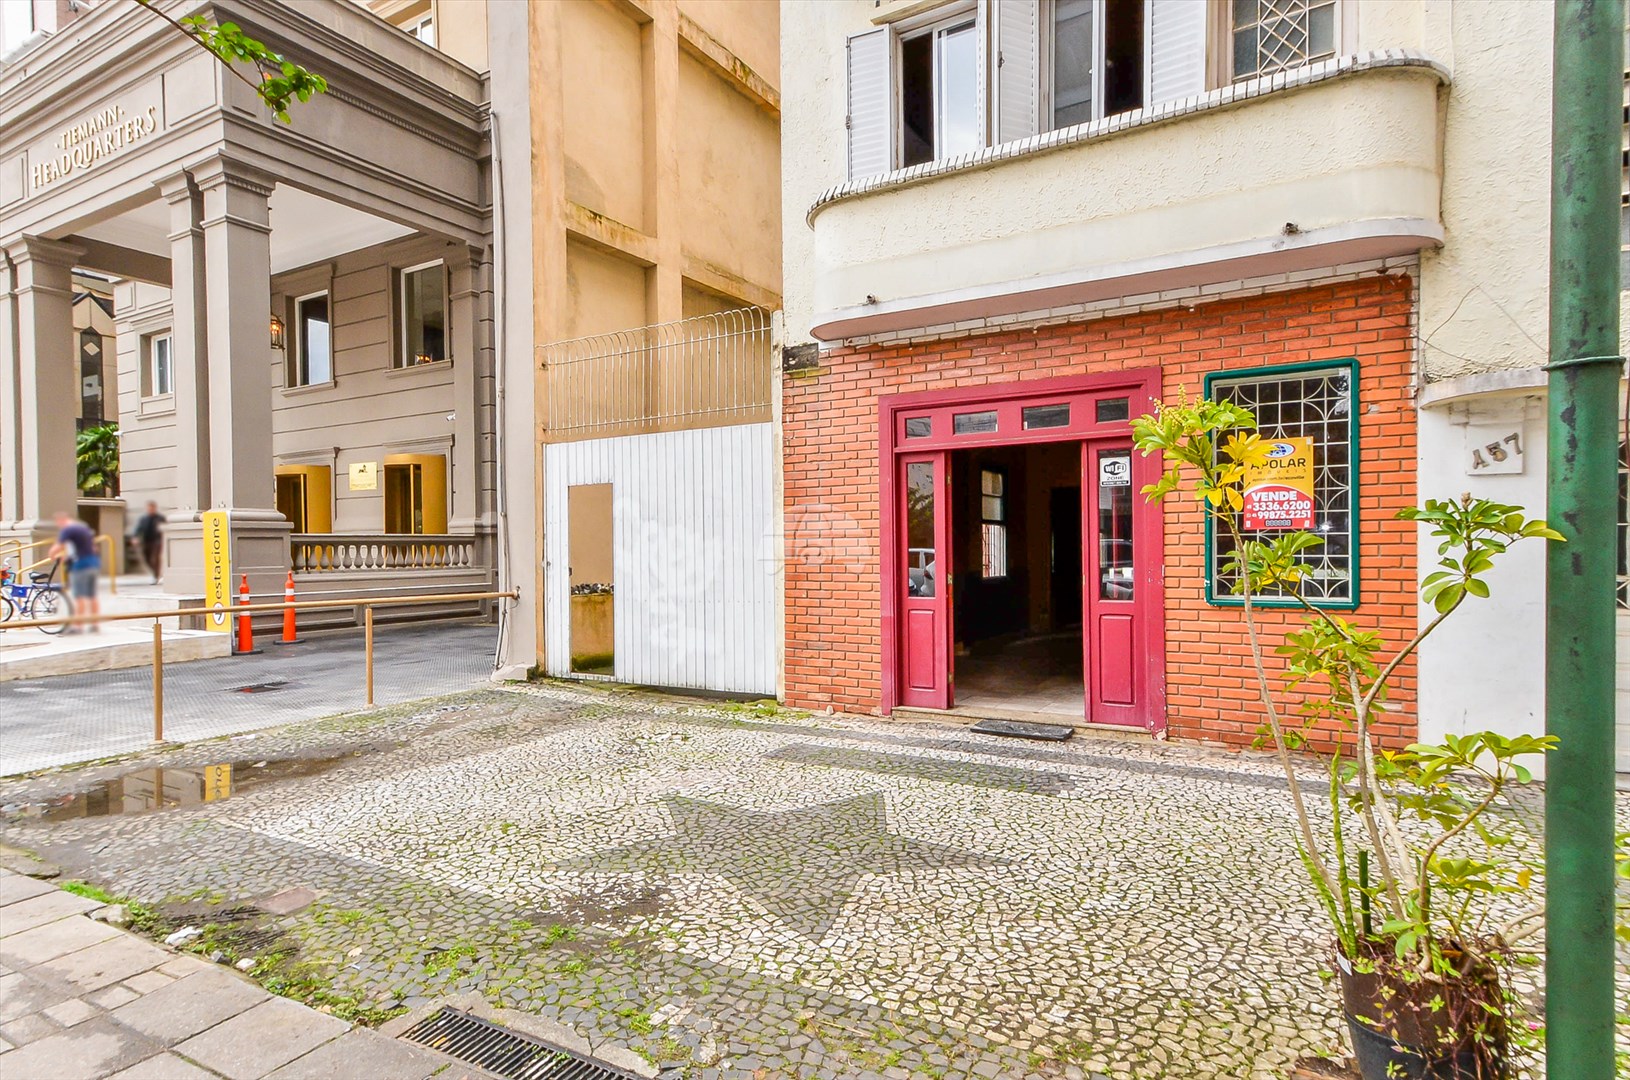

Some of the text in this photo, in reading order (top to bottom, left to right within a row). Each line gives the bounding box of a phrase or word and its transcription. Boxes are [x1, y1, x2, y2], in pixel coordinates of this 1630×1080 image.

[60, 105, 119, 150] TIEMANN
[32, 105, 156, 189] HEADQUARTERS
[1251, 491, 1297, 502] VENDE
[1253, 501, 1310, 511] 3336.6200
[1257, 510, 1311, 519] 99875.2251
[211, 517, 222, 600] estacione
